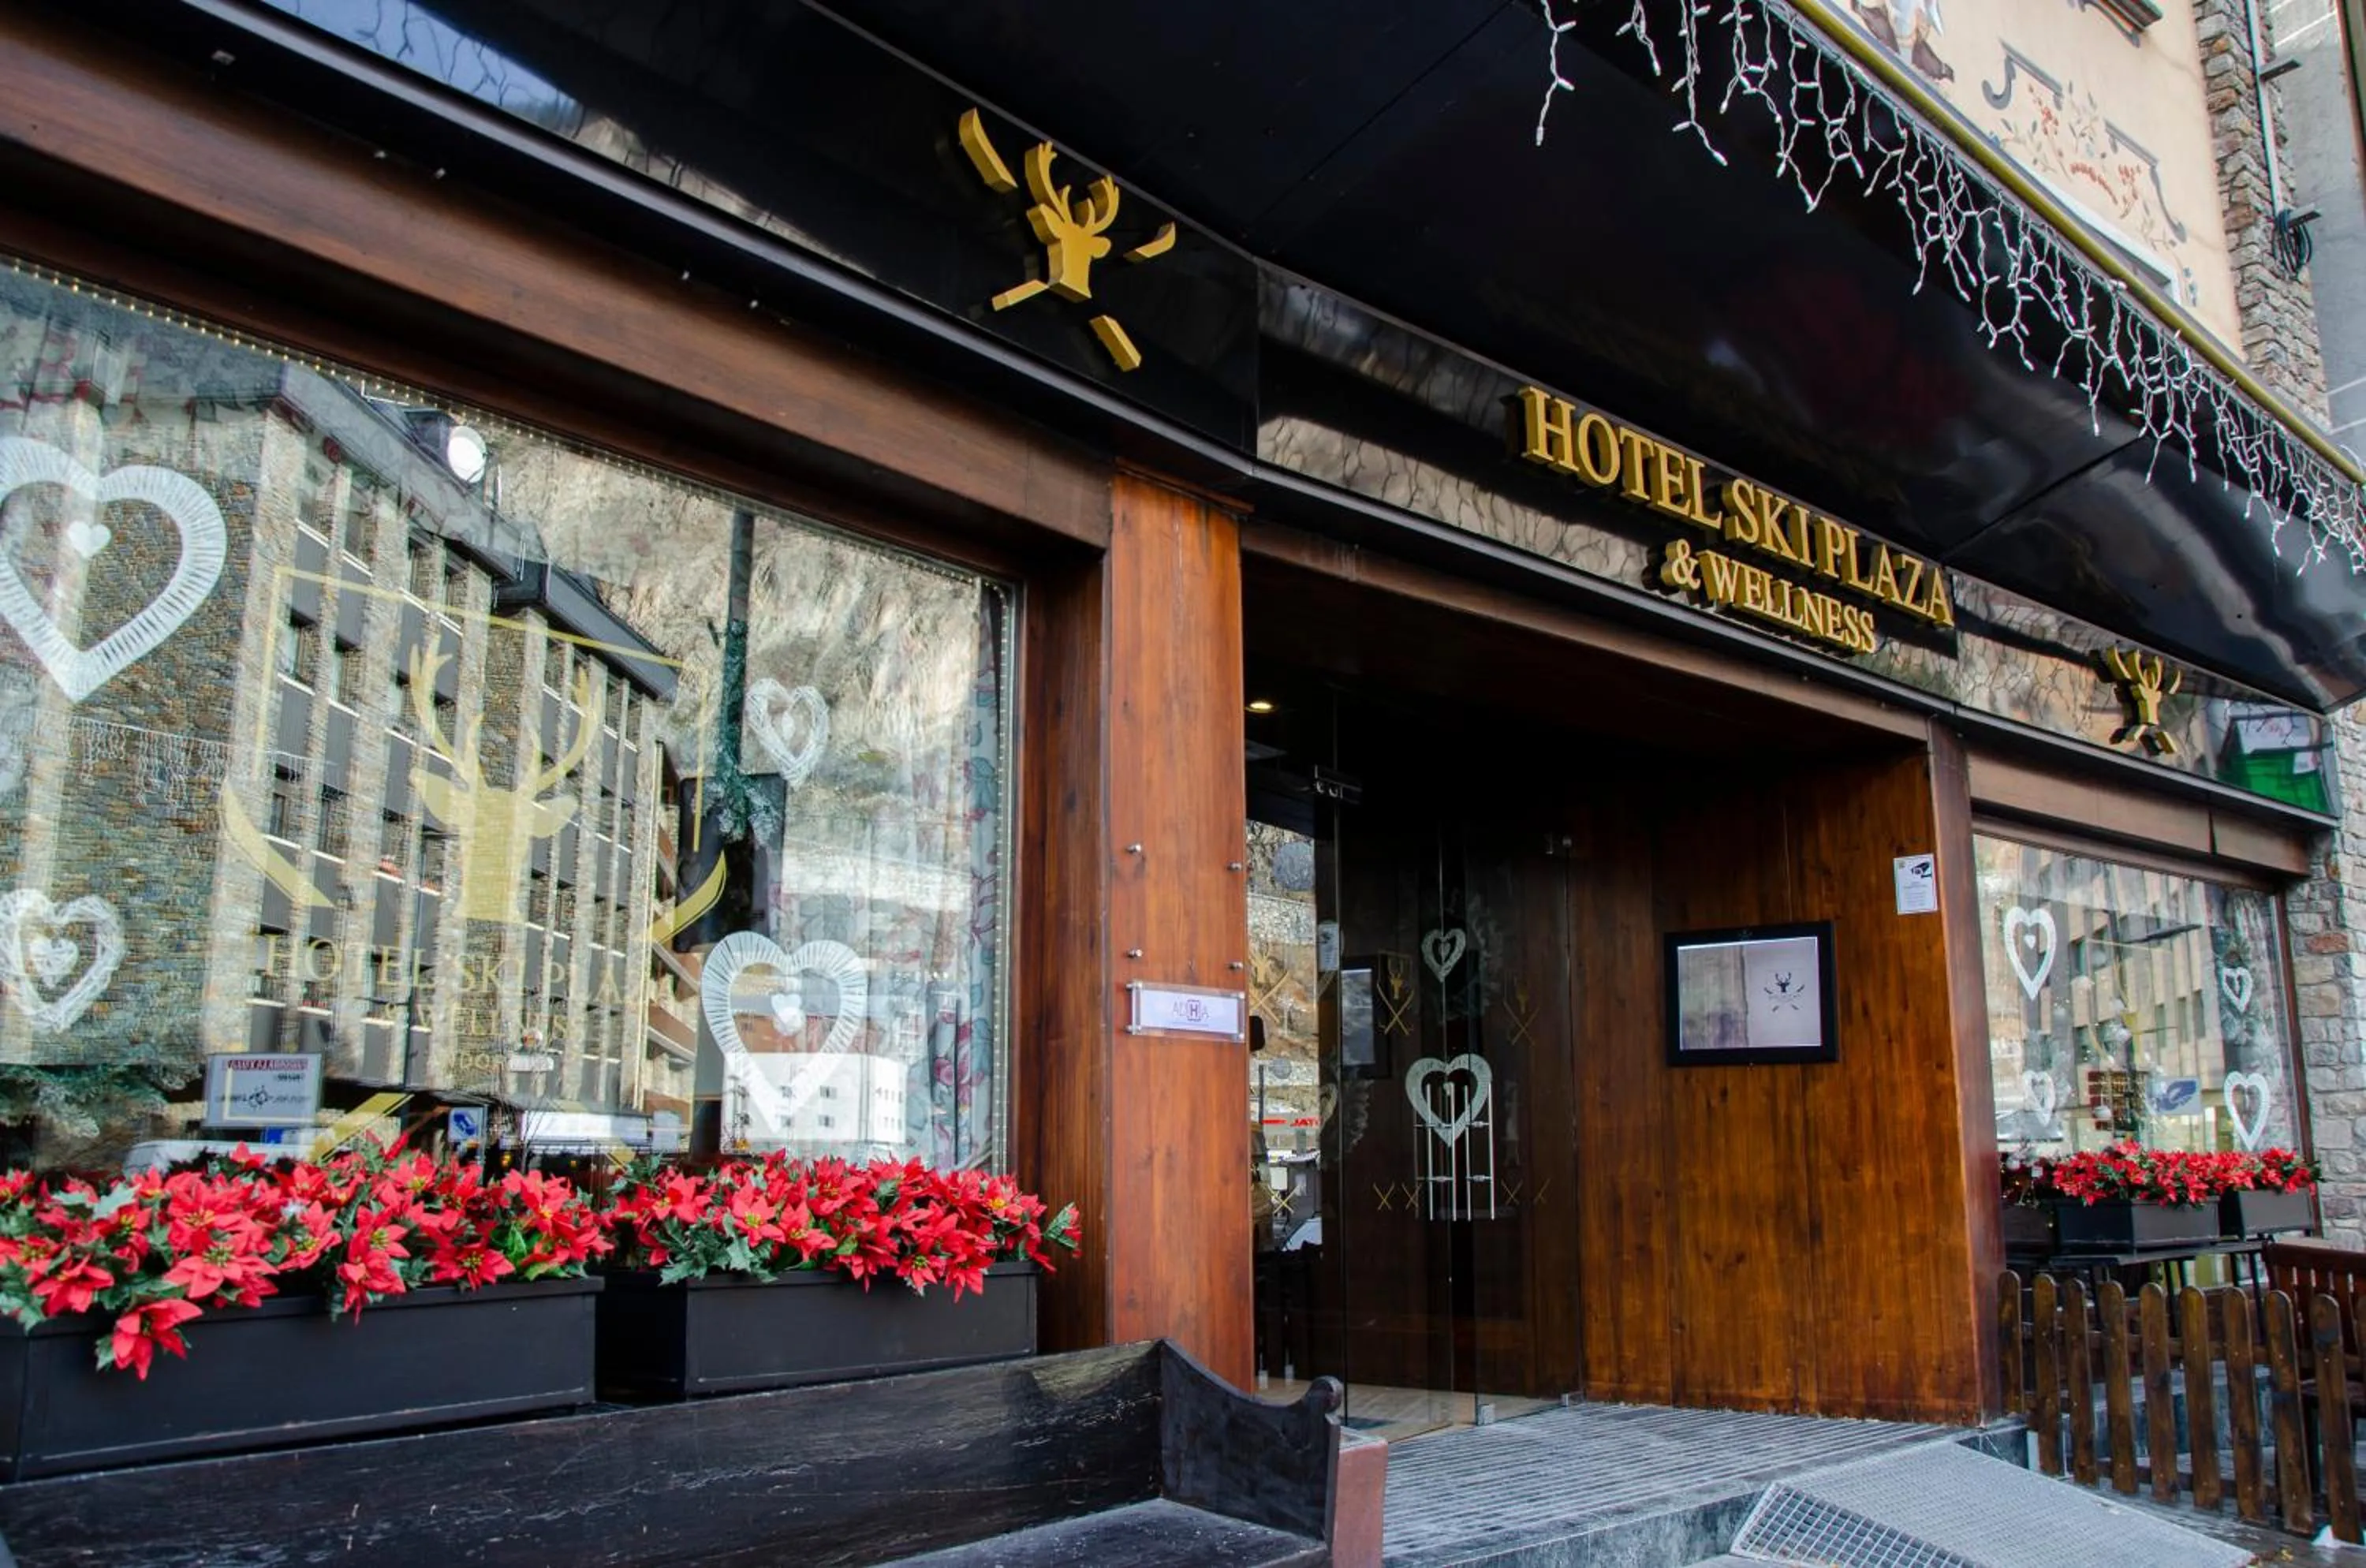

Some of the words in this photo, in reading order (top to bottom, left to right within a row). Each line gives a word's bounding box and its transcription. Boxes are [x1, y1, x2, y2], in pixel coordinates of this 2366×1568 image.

[1519, 385, 1722, 529] HOTEL
[1721, 478, 1813, 569] SKI
[1815, 514, 1955, 628] PLAZA
[1661, 538, 1700, 591] &
[1696, 549, 1877, 654] WELLNESS
